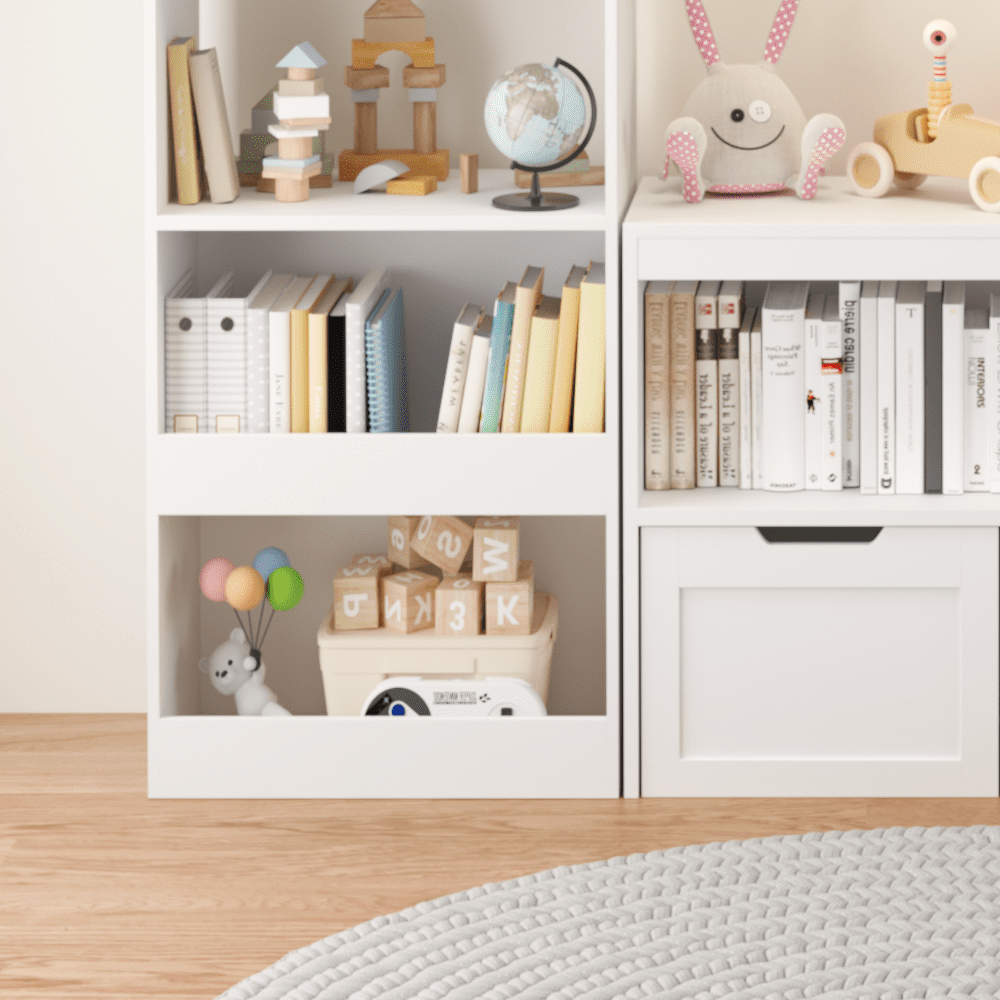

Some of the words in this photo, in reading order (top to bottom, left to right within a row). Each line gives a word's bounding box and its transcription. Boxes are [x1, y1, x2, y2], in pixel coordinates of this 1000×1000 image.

[906, 307, 917, 318] T
[977, 357, 985, 408] INTERIORS
[881, 478, 892, 489] D
[497, 595, 519, 625] K
